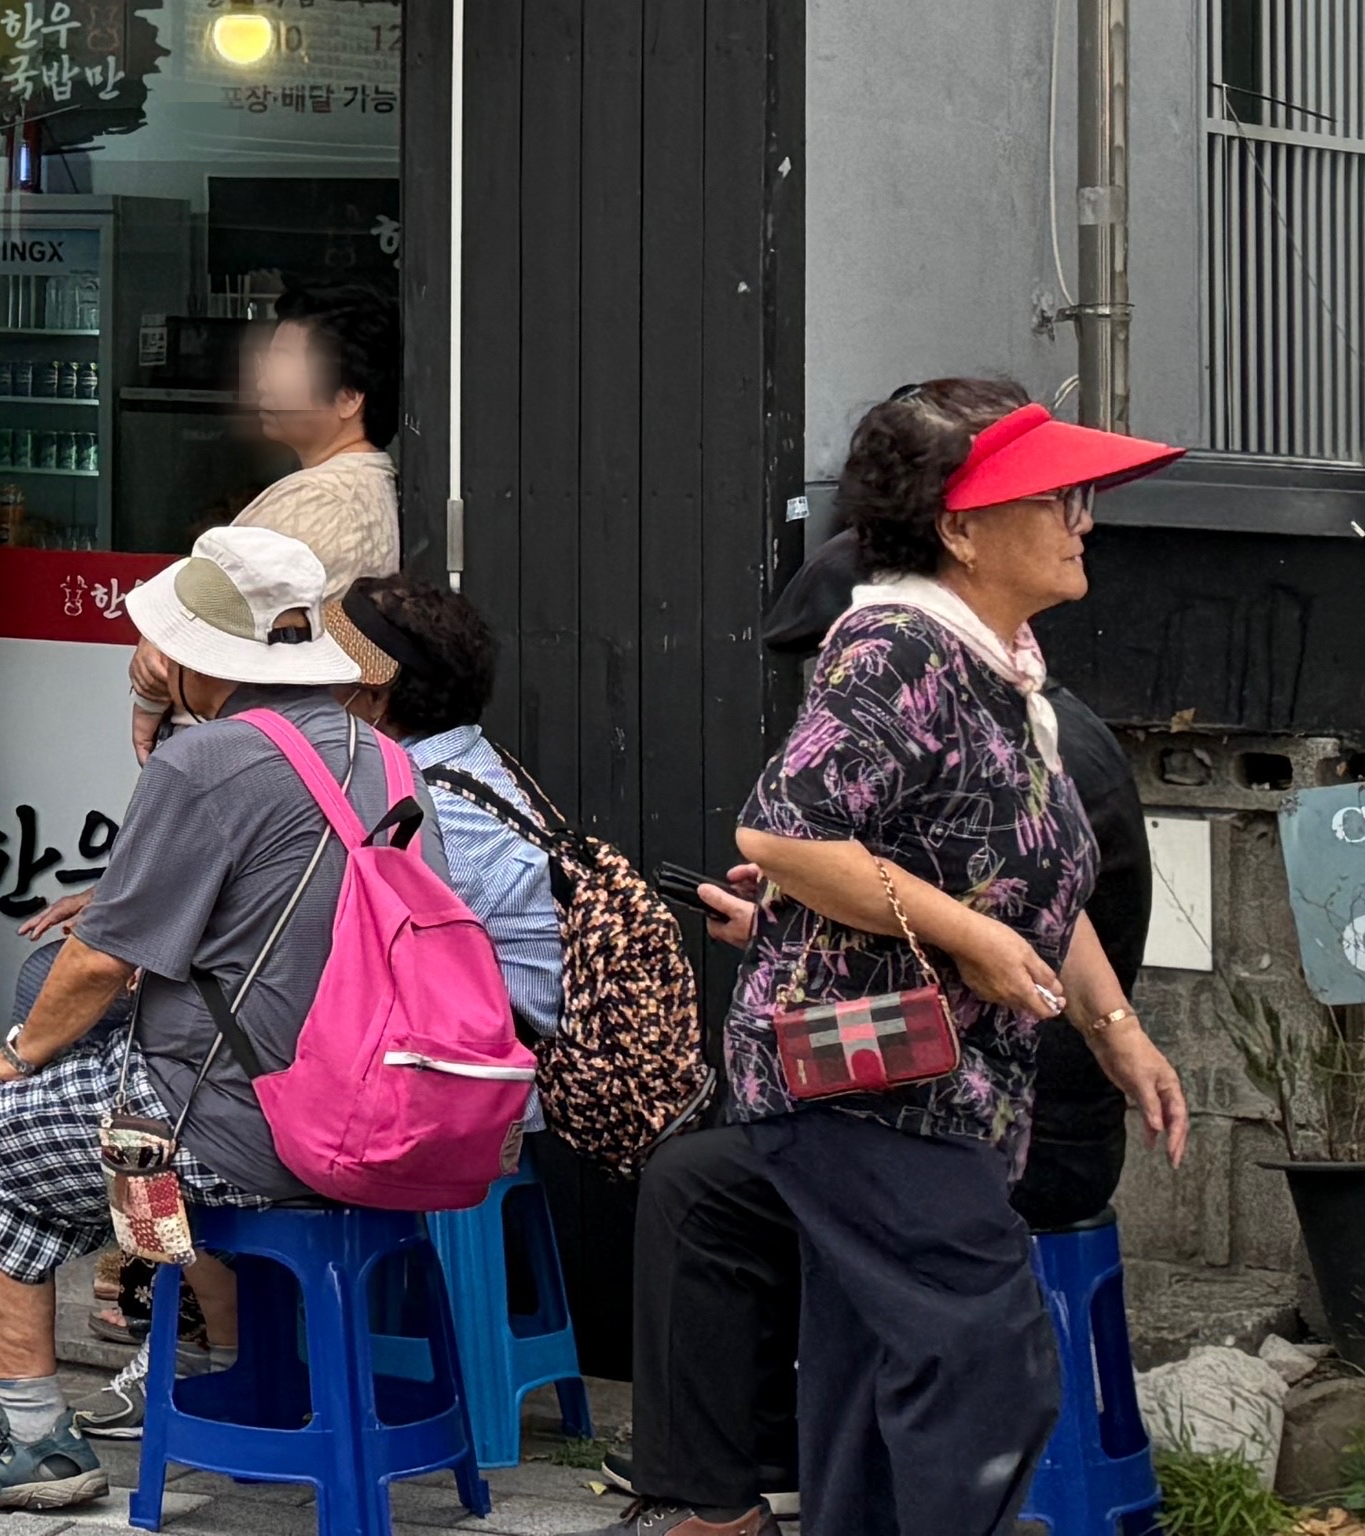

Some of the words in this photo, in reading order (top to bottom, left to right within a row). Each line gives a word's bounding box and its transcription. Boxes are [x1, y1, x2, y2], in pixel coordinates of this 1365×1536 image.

[0, 2, 82, 49] 한우
[2, 54, 126, 102] 국밥만
[343, 85, 397, 114] 가능
